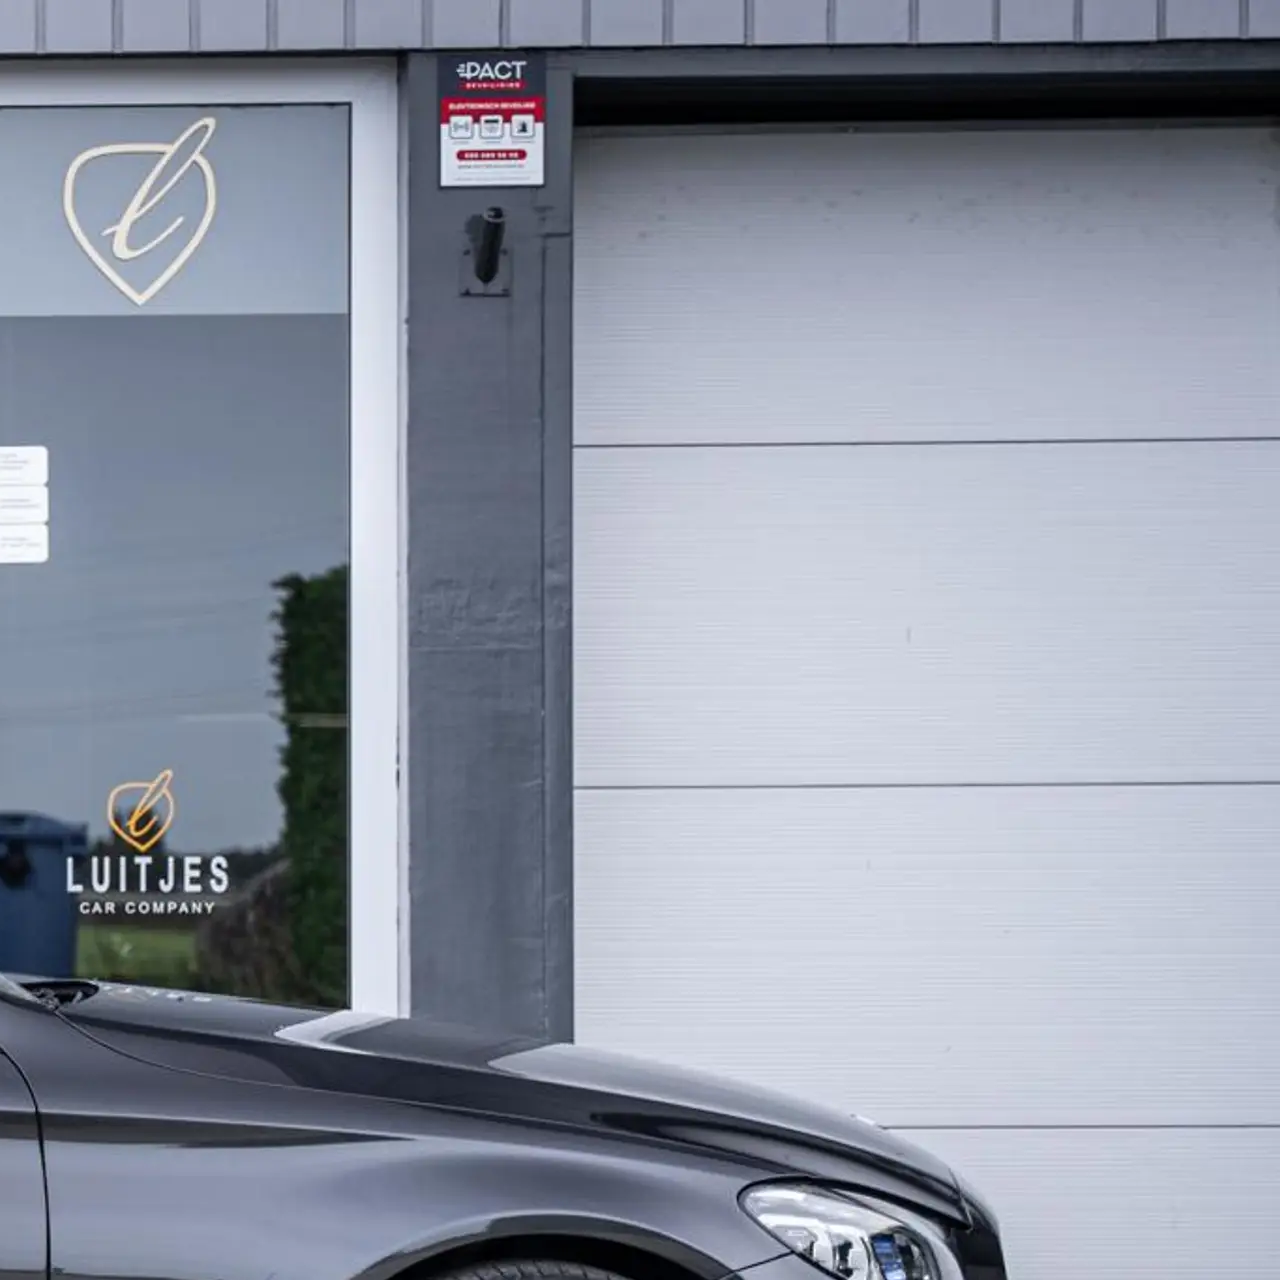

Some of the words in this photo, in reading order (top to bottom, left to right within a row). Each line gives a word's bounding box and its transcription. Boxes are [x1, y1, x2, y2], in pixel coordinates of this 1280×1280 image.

[66, 856, 229, 893] LUITJES
[79, 901, 116, 914] CAR
[125, 901, 215, 914] COMPANY
